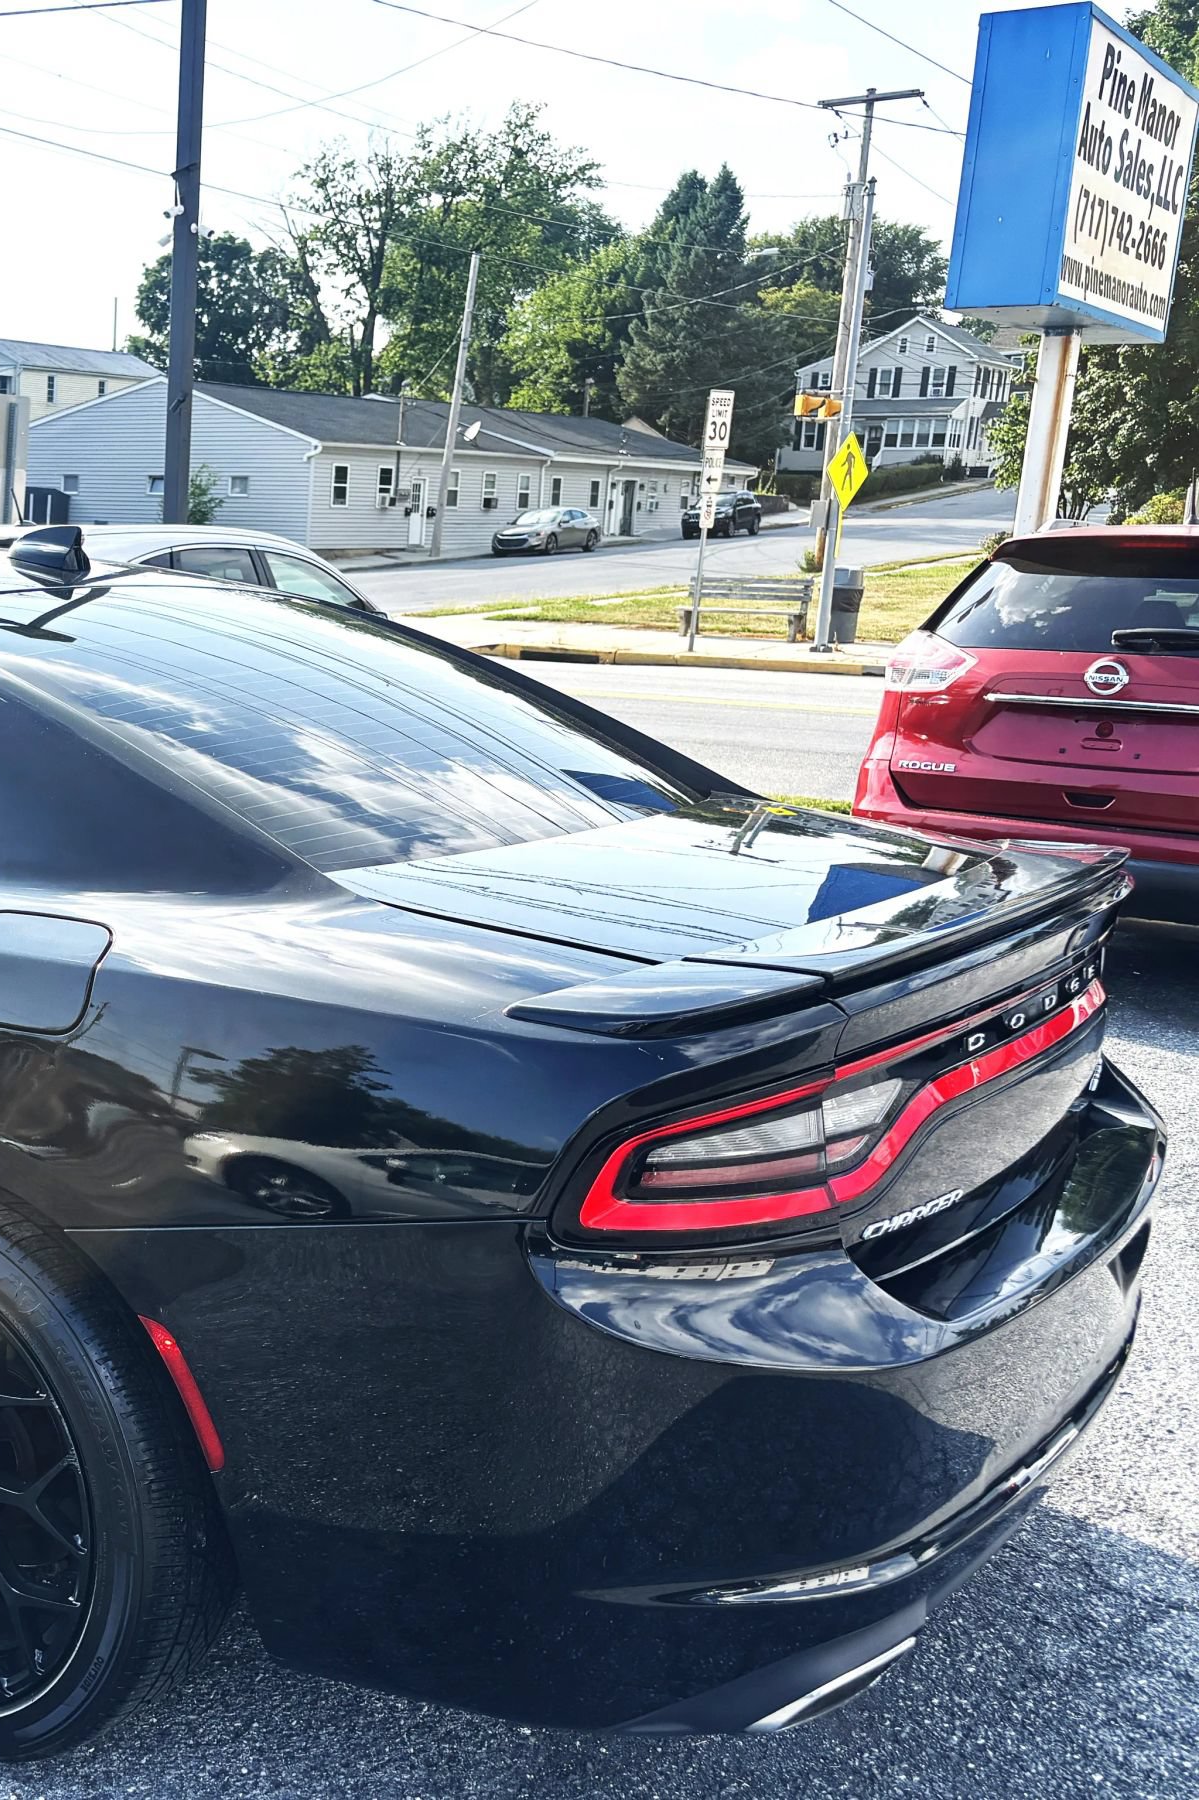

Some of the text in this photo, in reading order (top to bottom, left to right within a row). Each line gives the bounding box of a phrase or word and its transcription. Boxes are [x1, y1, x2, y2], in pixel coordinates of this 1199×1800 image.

[1099, 42, 1181, 150] Pine Manor
[1078, 102, 1112, 176] Auto
[1061, 254, 1166, 321] www.pinemanorauto.com
[711, 397, 731, 407] SPEED
[712, 409, 728, 418] LIMIT
[708, 421, 727, 441] 30
[1088, 674, 1125, 684] NISSAN
[898, 759, 955, 772] ROGUE
[965, 964, 1096, 1051] DODGE
[861, 1189, 963, 1241] CHARGER
